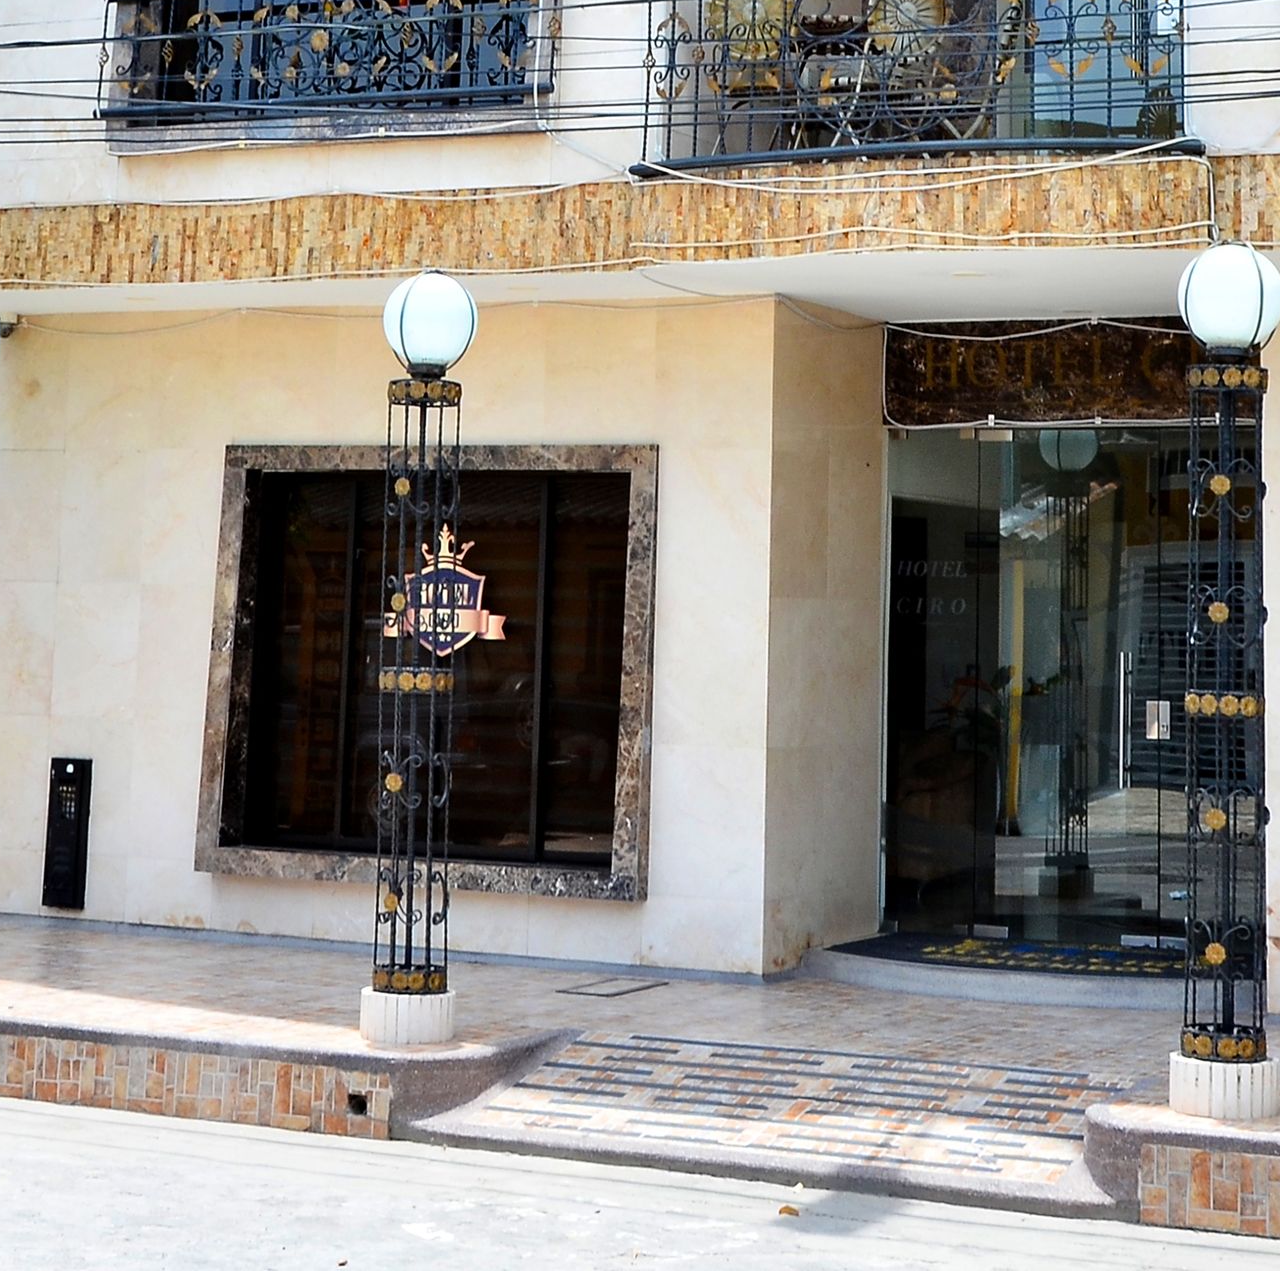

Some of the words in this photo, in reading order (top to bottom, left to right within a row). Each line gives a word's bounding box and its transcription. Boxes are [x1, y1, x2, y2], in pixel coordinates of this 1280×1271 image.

[924, 338, 1126, 388] HOTEL
[896, 561, 967, 577] HOTEL
[896, 597, 967, 615] CIRO
